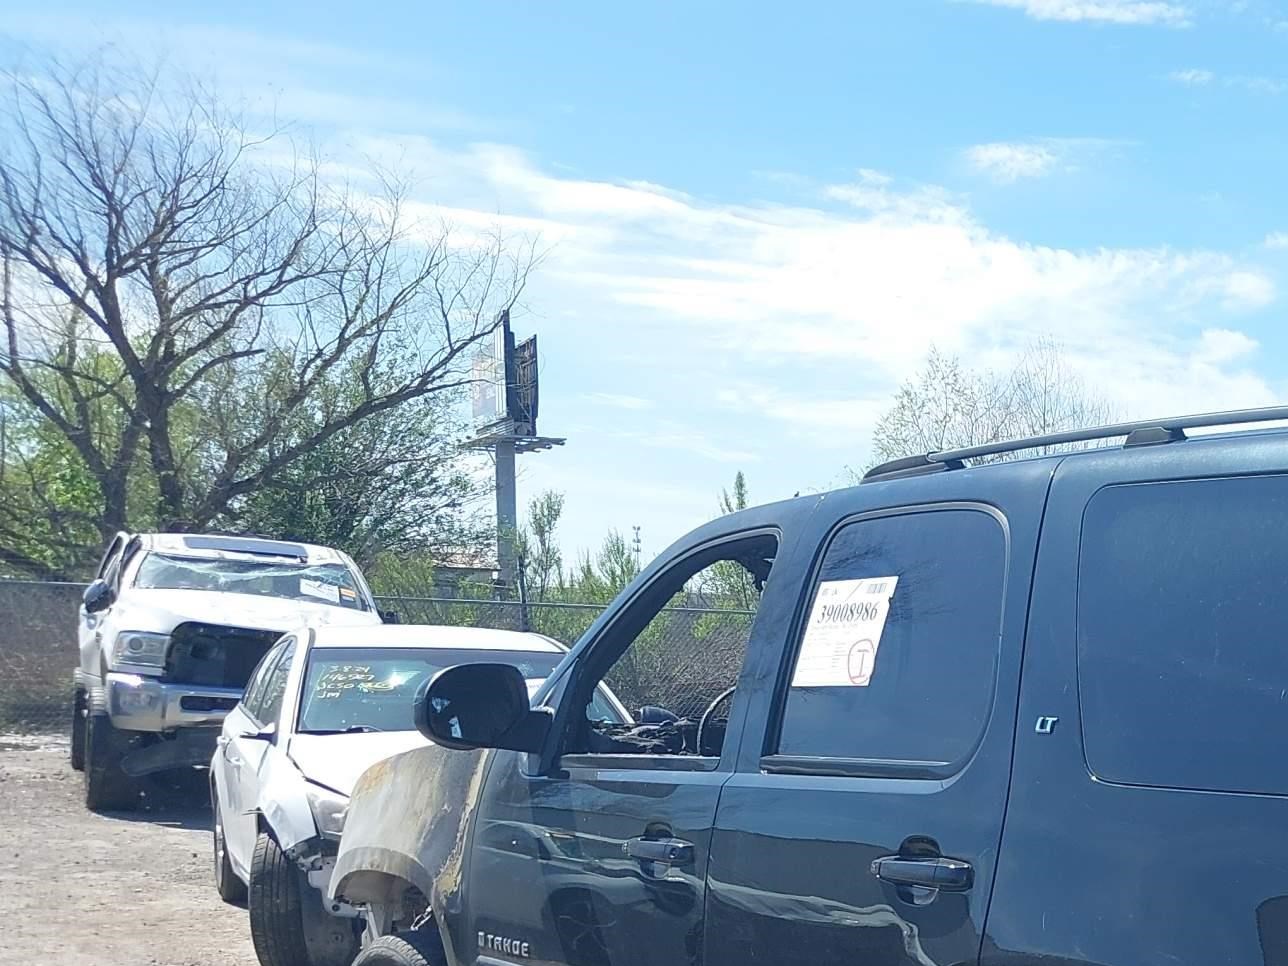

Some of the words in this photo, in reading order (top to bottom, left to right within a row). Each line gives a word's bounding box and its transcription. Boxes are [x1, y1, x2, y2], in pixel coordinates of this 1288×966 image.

[817, 601, 881, 625] 39008986
[1035, 716, 1058, 734] LT
[486, 934, 529, 957] TAHOE
